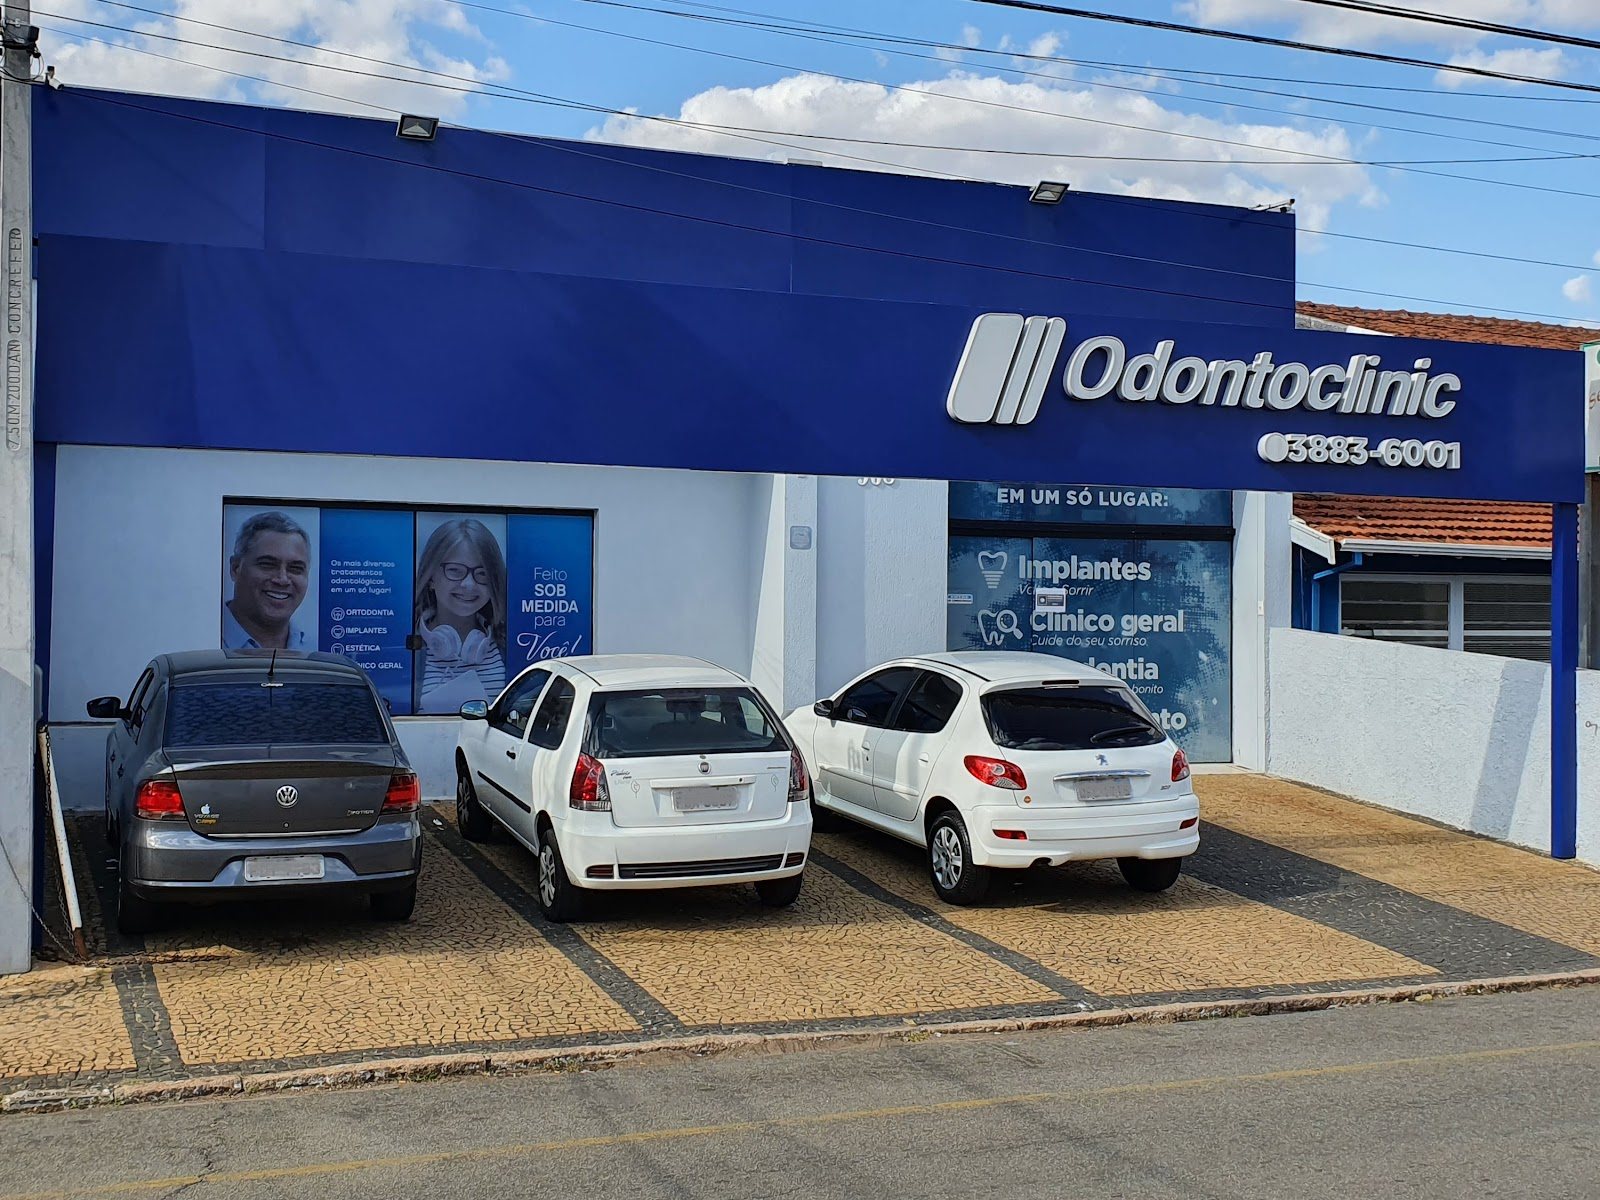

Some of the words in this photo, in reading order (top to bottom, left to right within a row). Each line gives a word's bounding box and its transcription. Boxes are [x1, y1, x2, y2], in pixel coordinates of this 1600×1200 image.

[1062, 335, 1461, 419] Odontoclinic
[1286, 433, 1461, 470] 3883-6001
[997, 488, 1024, 504] EM
[1031, 489, 1060, 505] UM
[1066, 487, 1093, 506] SÓ
[1099, 491, 1169, 507] LUGAR:
[534, 567, 568, 581] Feito
[1019, 555, 1151, 584] Implantes
[331, 578, 384, 586] odontológicos
[369, 587, 391, 595] lugar!
[534, 583, 566, 597] SOB
[1062, 584, 1094, 596] Sorrir
[521, 599, 579, 613] MEDIDA
[534, 615, 566, 630] para
[1121, 610, 1184, 637] geral
[345, 643, 380, 651] ESTÉTICA
[517, 631, 582, 660] Você!
[1031, 634, 1063, 646] Cuide
[1066, 634, 1082, 646] do
[1086, 637, 1105, 647] seu
[1131, 684, 1164, 694] bonito
